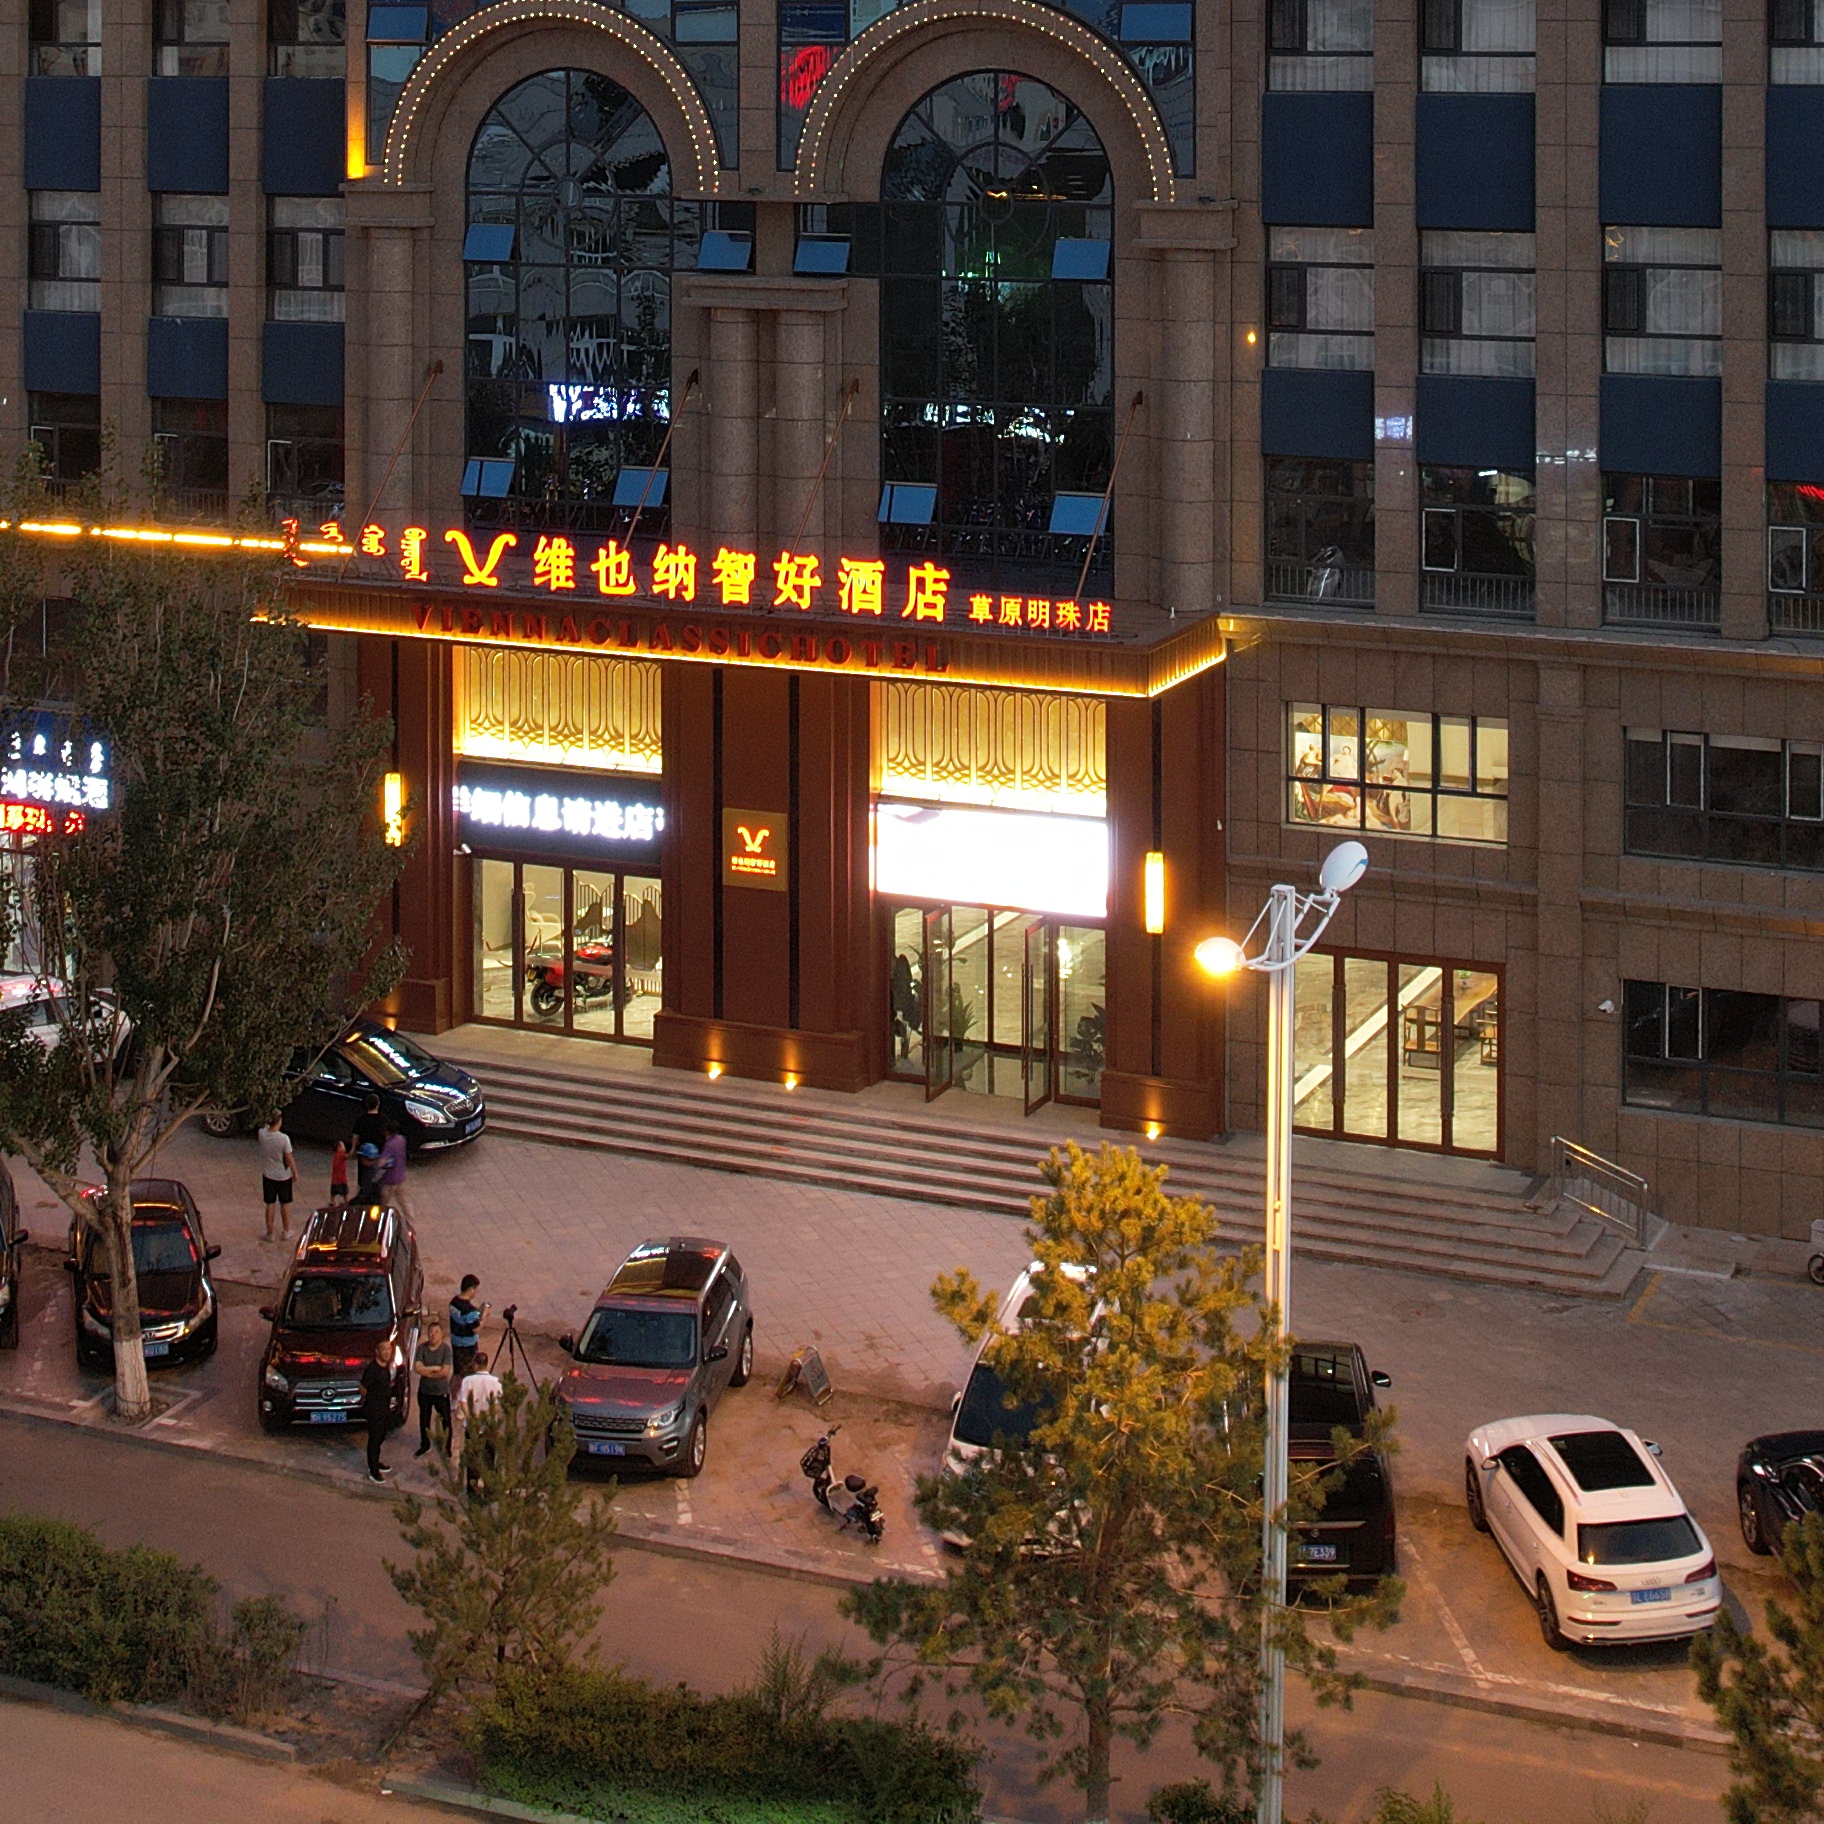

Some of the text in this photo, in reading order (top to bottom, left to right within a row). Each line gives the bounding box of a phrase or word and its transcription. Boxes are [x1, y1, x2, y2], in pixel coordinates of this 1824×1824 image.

[532, 535, 952, 623] 维也纳智好酒店
[968, 593, 1112, 633] 草原明珠店
